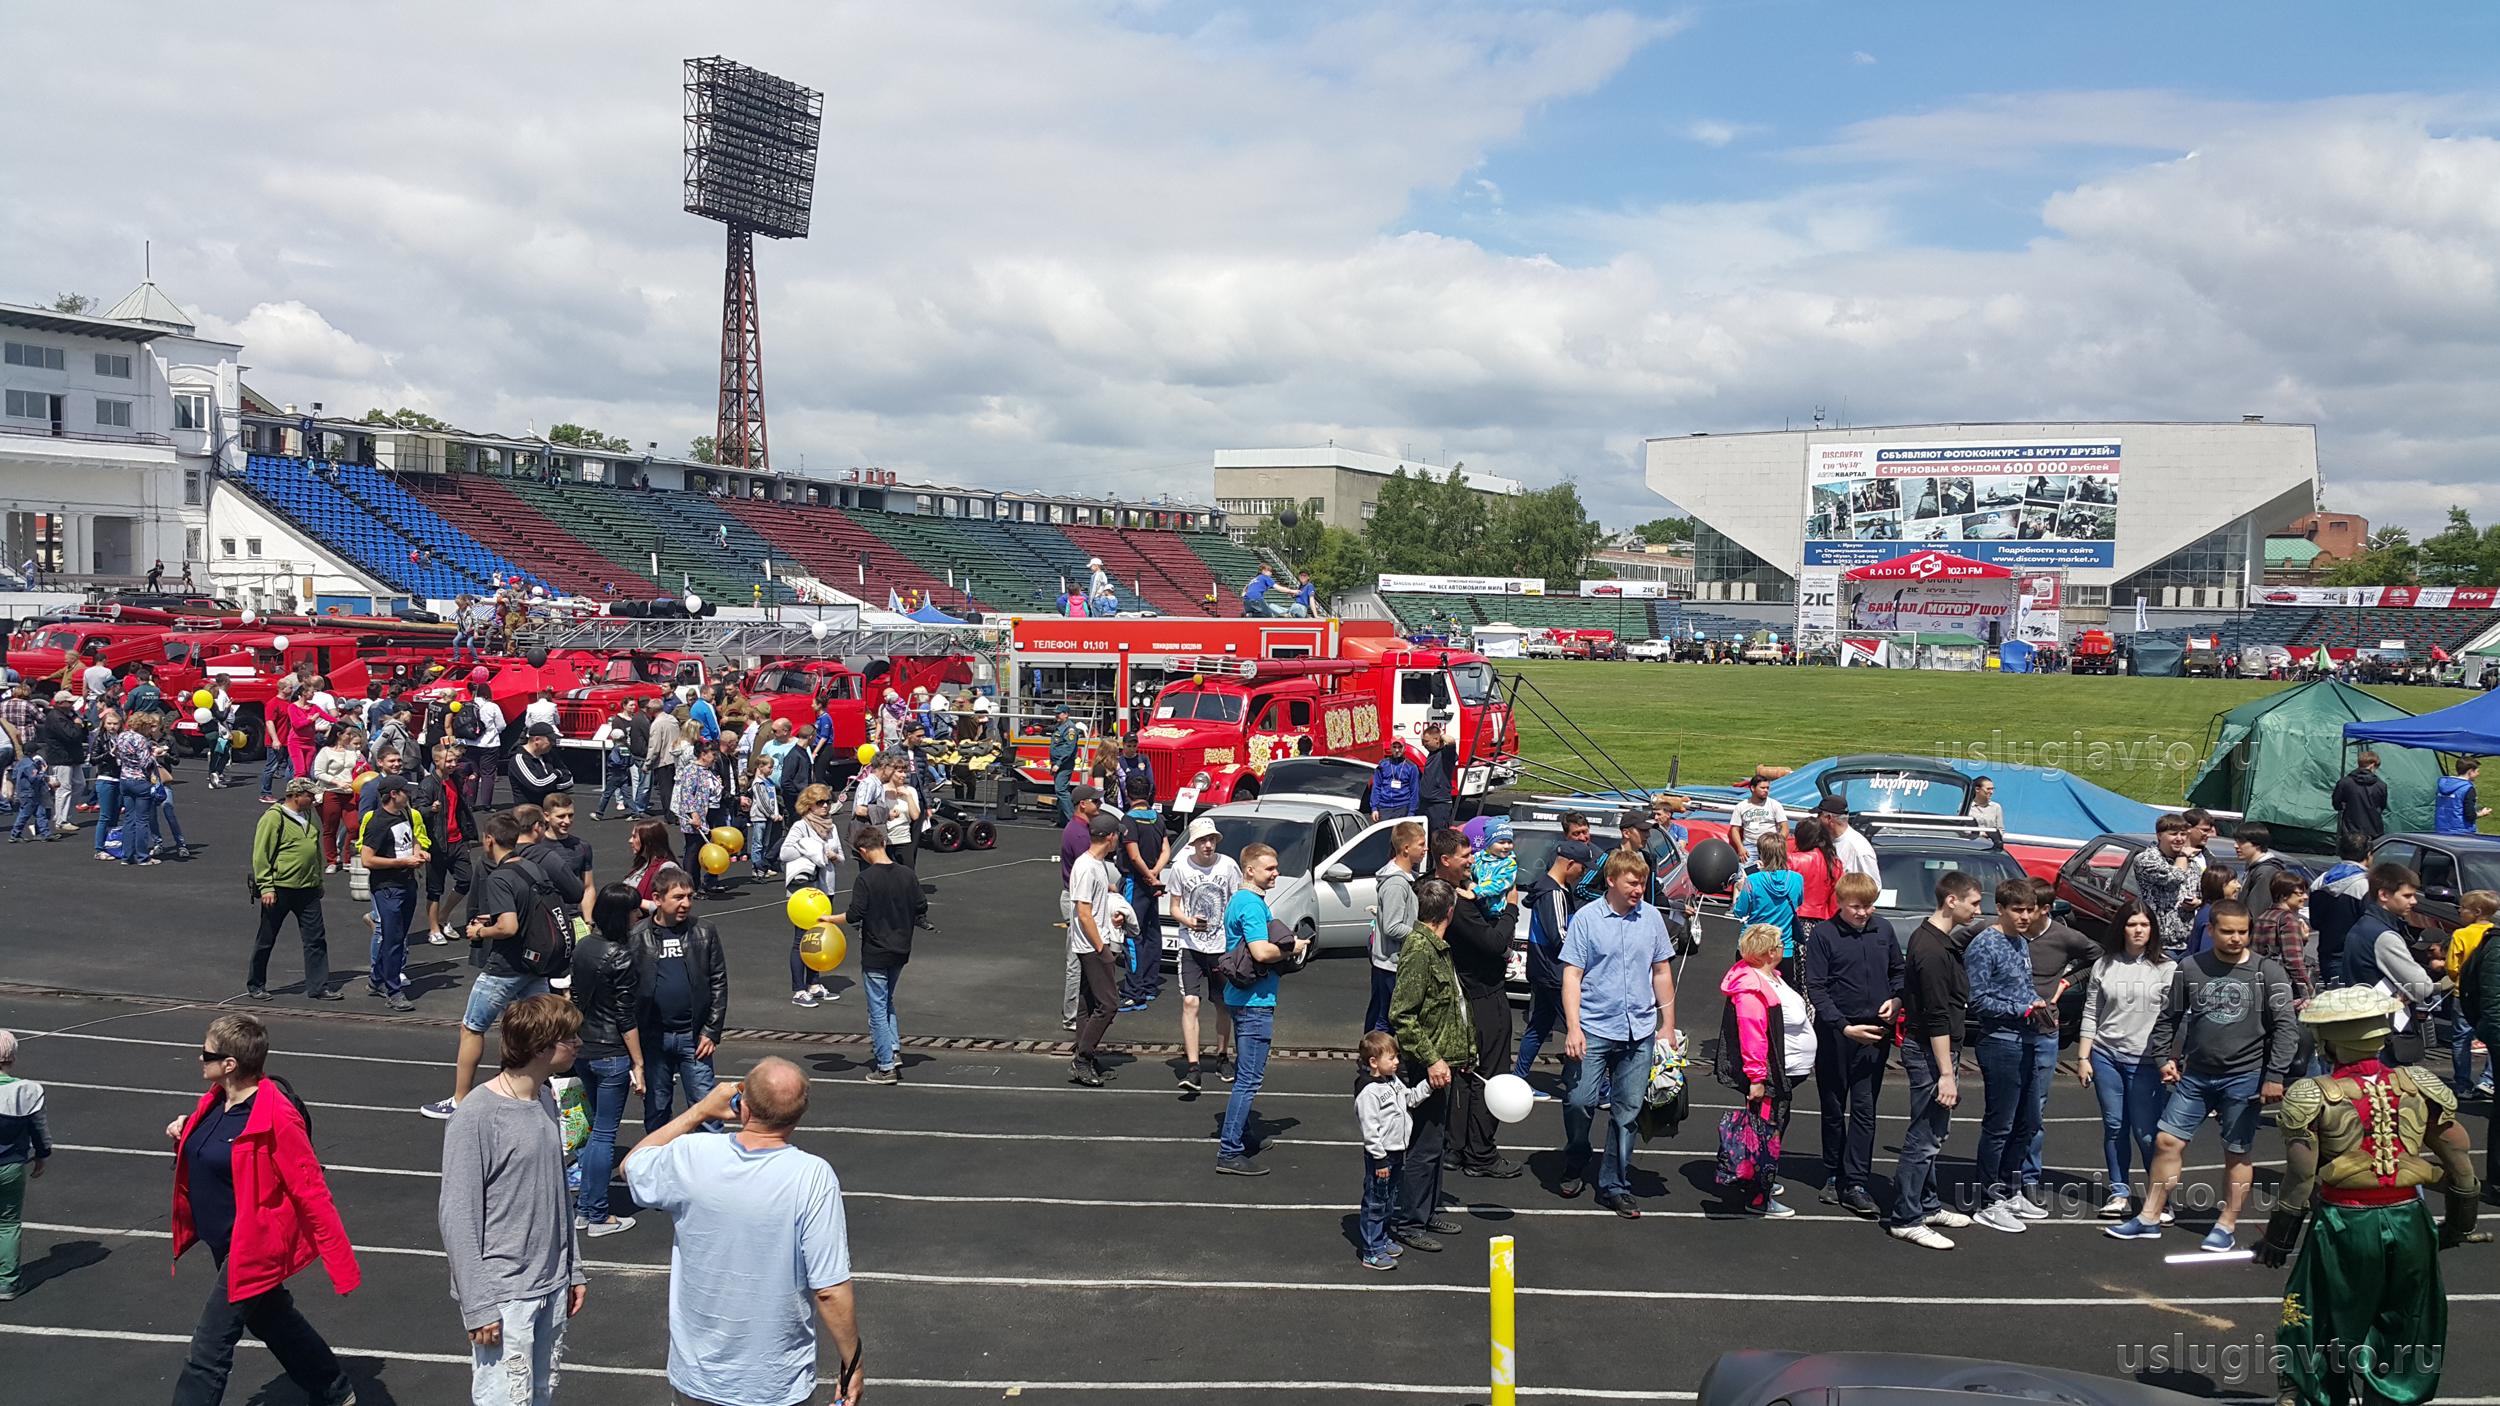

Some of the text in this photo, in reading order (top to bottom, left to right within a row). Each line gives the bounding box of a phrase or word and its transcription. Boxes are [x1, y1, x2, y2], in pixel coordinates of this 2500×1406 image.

[304, 419, 311, 430] 6
[1822, 450, 1864, 459] DISCOVERY
[1881, 445, 2116, 459] ОБЪЯВЛЯЮТ ФОТОКОНКУРС «В КРУГУ ДРУЗЕЙ»
[1889, 465, 1949, 474] ПРИЗОВЫМ
[1951, 464, 2001, 474] ФОНДОМ
[2003, 462, 2033, 474] 600
[2037, 461, 2068, 473] 000
[2070, 463, 2109, 473] рублей
[1998, 546, 2054, 555] Подробности
[2070, 546, 2094, 554] сайте
[1992, 554, 2100, 565] www.discovery-market.ru
[1869, 568, 1906, 576] RADIO
[1947, 567, 1967, 575] 102.1
[1968, 567, 1982, 575] FM
[1803, 593, 1835, 606] ZIC
[1927, 603, 1971, 615] МОТОР
[1979, 605, 2008, 615] ШОУ
[1033, 640, 1109, 650] ТЕЛЕФОН 01,101
[1532, 812, 1560, 821] THULE
